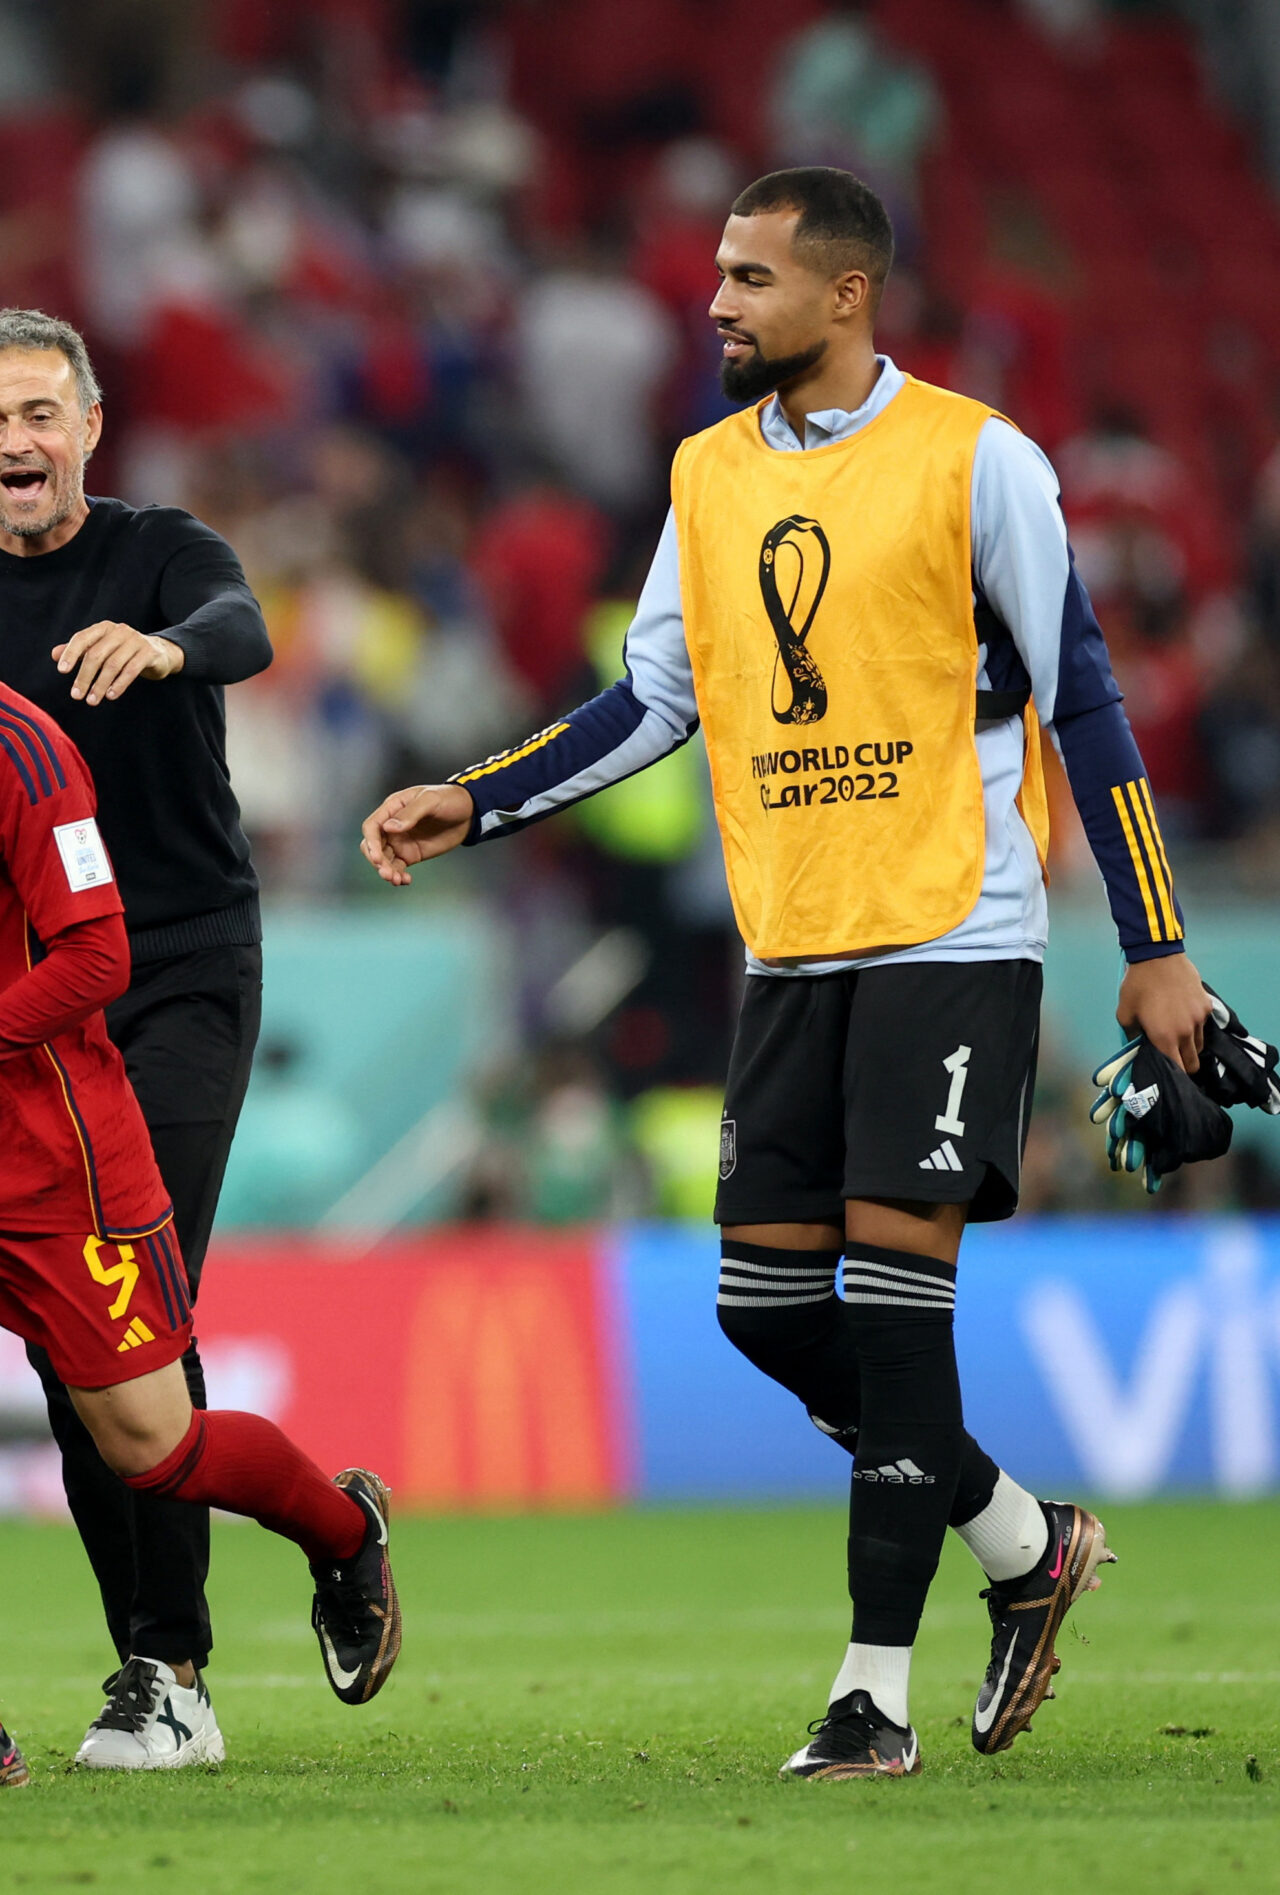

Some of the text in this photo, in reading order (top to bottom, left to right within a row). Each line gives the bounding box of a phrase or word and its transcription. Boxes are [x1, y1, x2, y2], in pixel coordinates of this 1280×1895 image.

[854, 740, 914, 766] CUP
[935, 1044, 972, 1137] 1
[82, 1233, 140, 1321] 9
[852, 1469, 937, 1485] adidas
